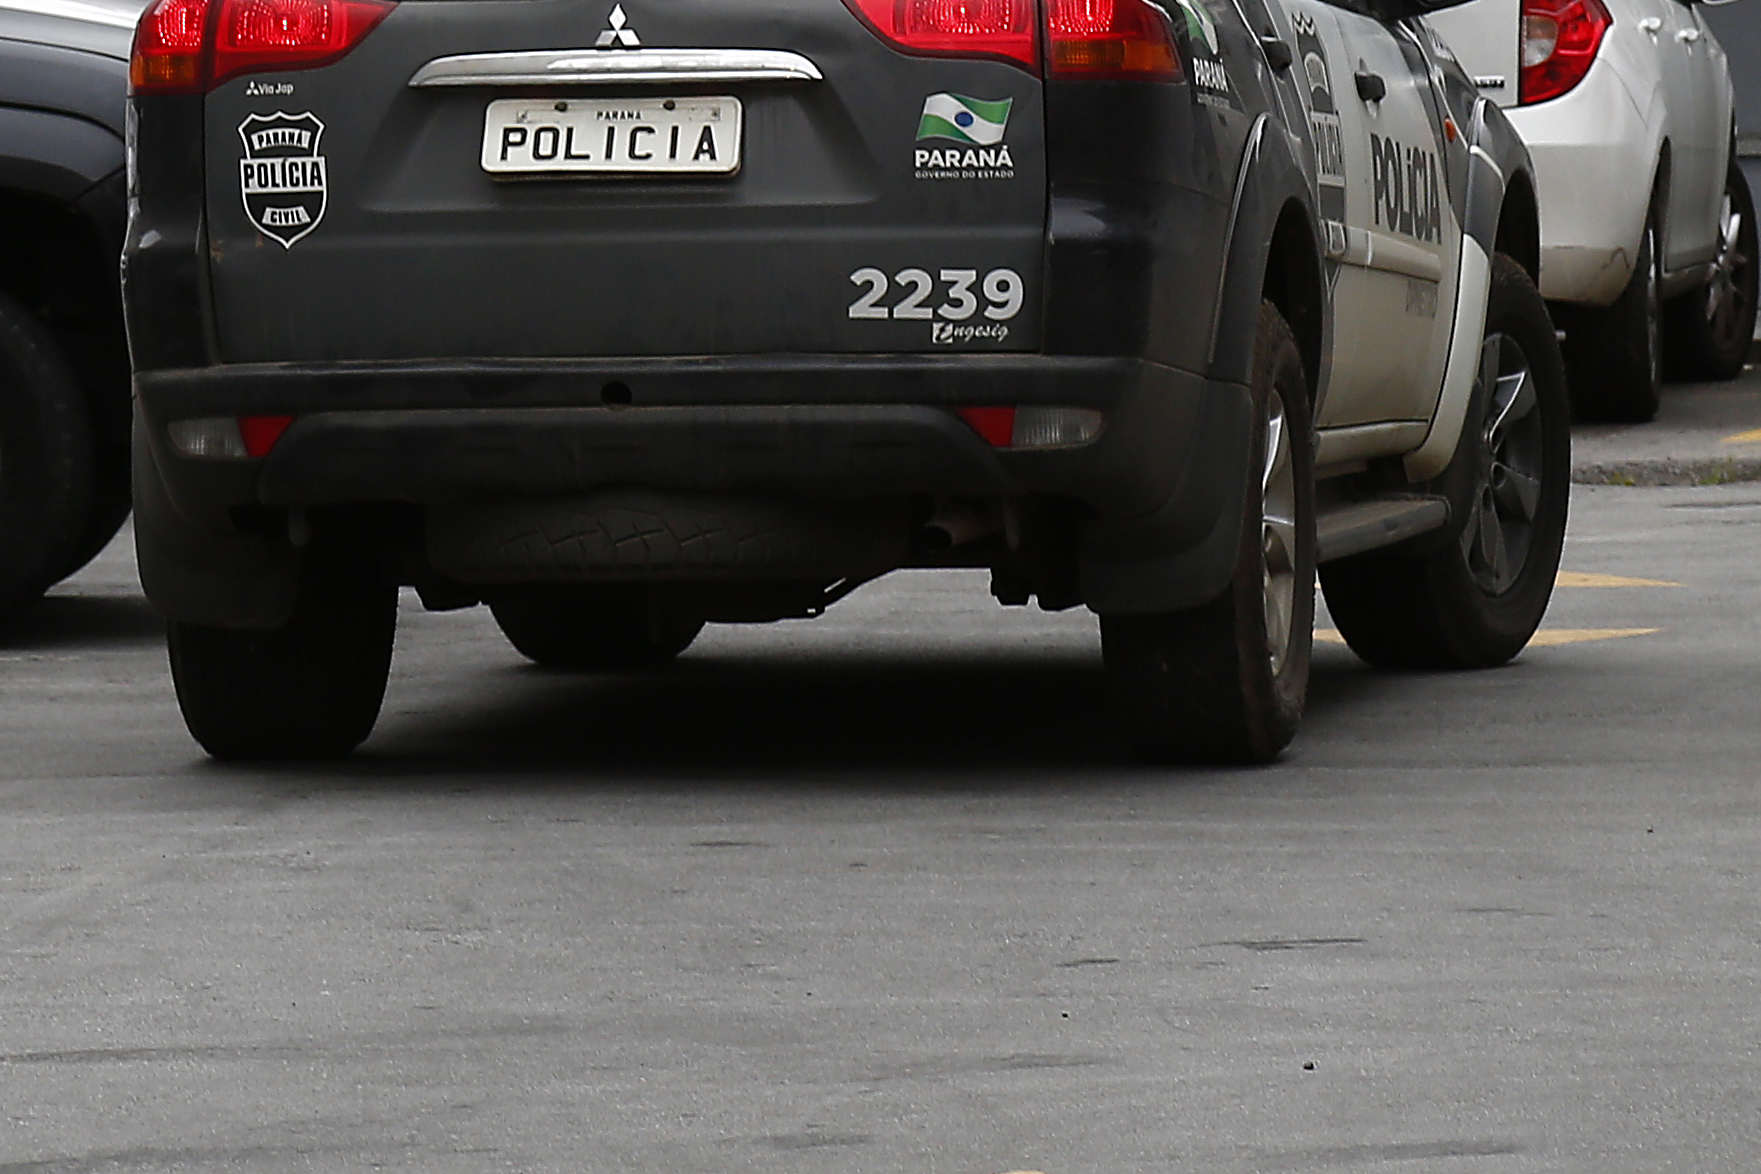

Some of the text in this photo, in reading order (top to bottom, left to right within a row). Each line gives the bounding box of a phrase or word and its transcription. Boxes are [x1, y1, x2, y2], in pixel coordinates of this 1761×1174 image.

[258, 82, 294, 96] Via Jap
[501, 125, 717, 161] POLICIA
[915, 145, 1014, 168] PARANÁ
[243, 159, 323, 189] POLÍCIA
[915, 170, 1014, 179] GOVERNO DO ESTADO
[270, 209, 301, 224] CIVIL
[849, 267, 1024, 320] 2239
